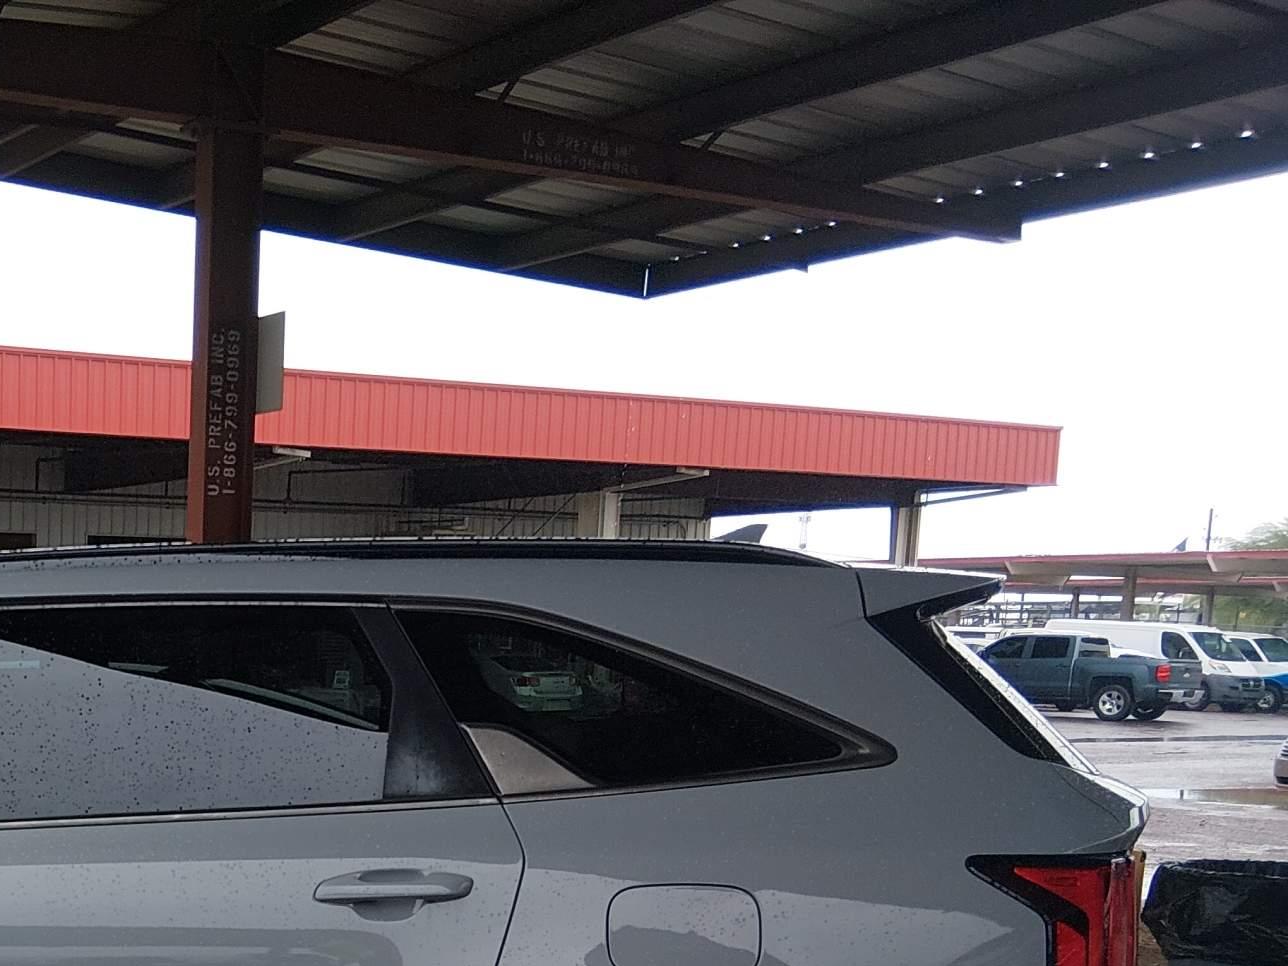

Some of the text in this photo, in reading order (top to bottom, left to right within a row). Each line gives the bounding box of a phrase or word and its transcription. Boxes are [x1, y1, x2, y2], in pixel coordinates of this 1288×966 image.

[207, 327, 226, 497] U.S. PREFAB INC.
[221, 328, 242, 496] 1-866-799-0969
